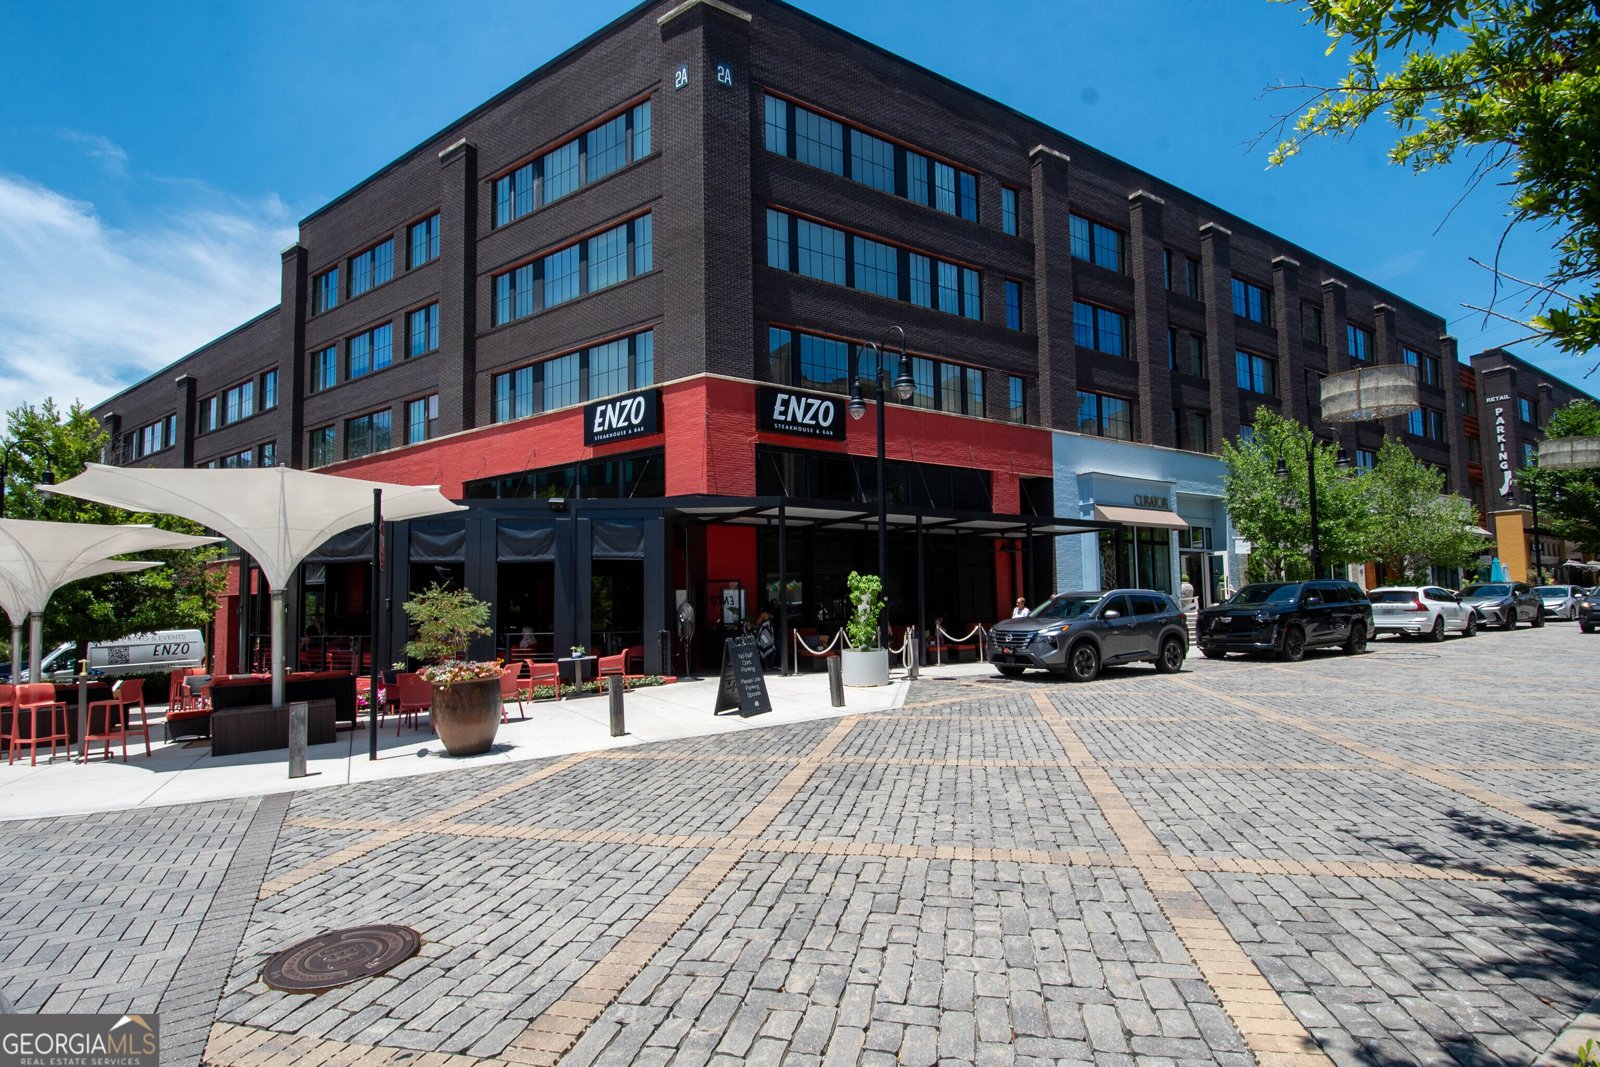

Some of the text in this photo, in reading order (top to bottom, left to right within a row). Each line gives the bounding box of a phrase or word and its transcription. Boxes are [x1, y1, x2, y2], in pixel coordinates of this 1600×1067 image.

[676, 68, 688, 88] 2A
[717, 65, 732, 85] 2A
[1486, 394, 1510, 403] RETAIL
[593, 396, 646, 433] ENZO
[772, 393, 835, 427] ENZO
[594, 429, 626, 441] STEAKHOUSE
[774, 423, 814, 433] STEAKHOUSE
[1495, 407, 1509, 470] PARKING
[158, 633, 186, 641] EVENTS
[153, 642, 190, 656] ENZO
